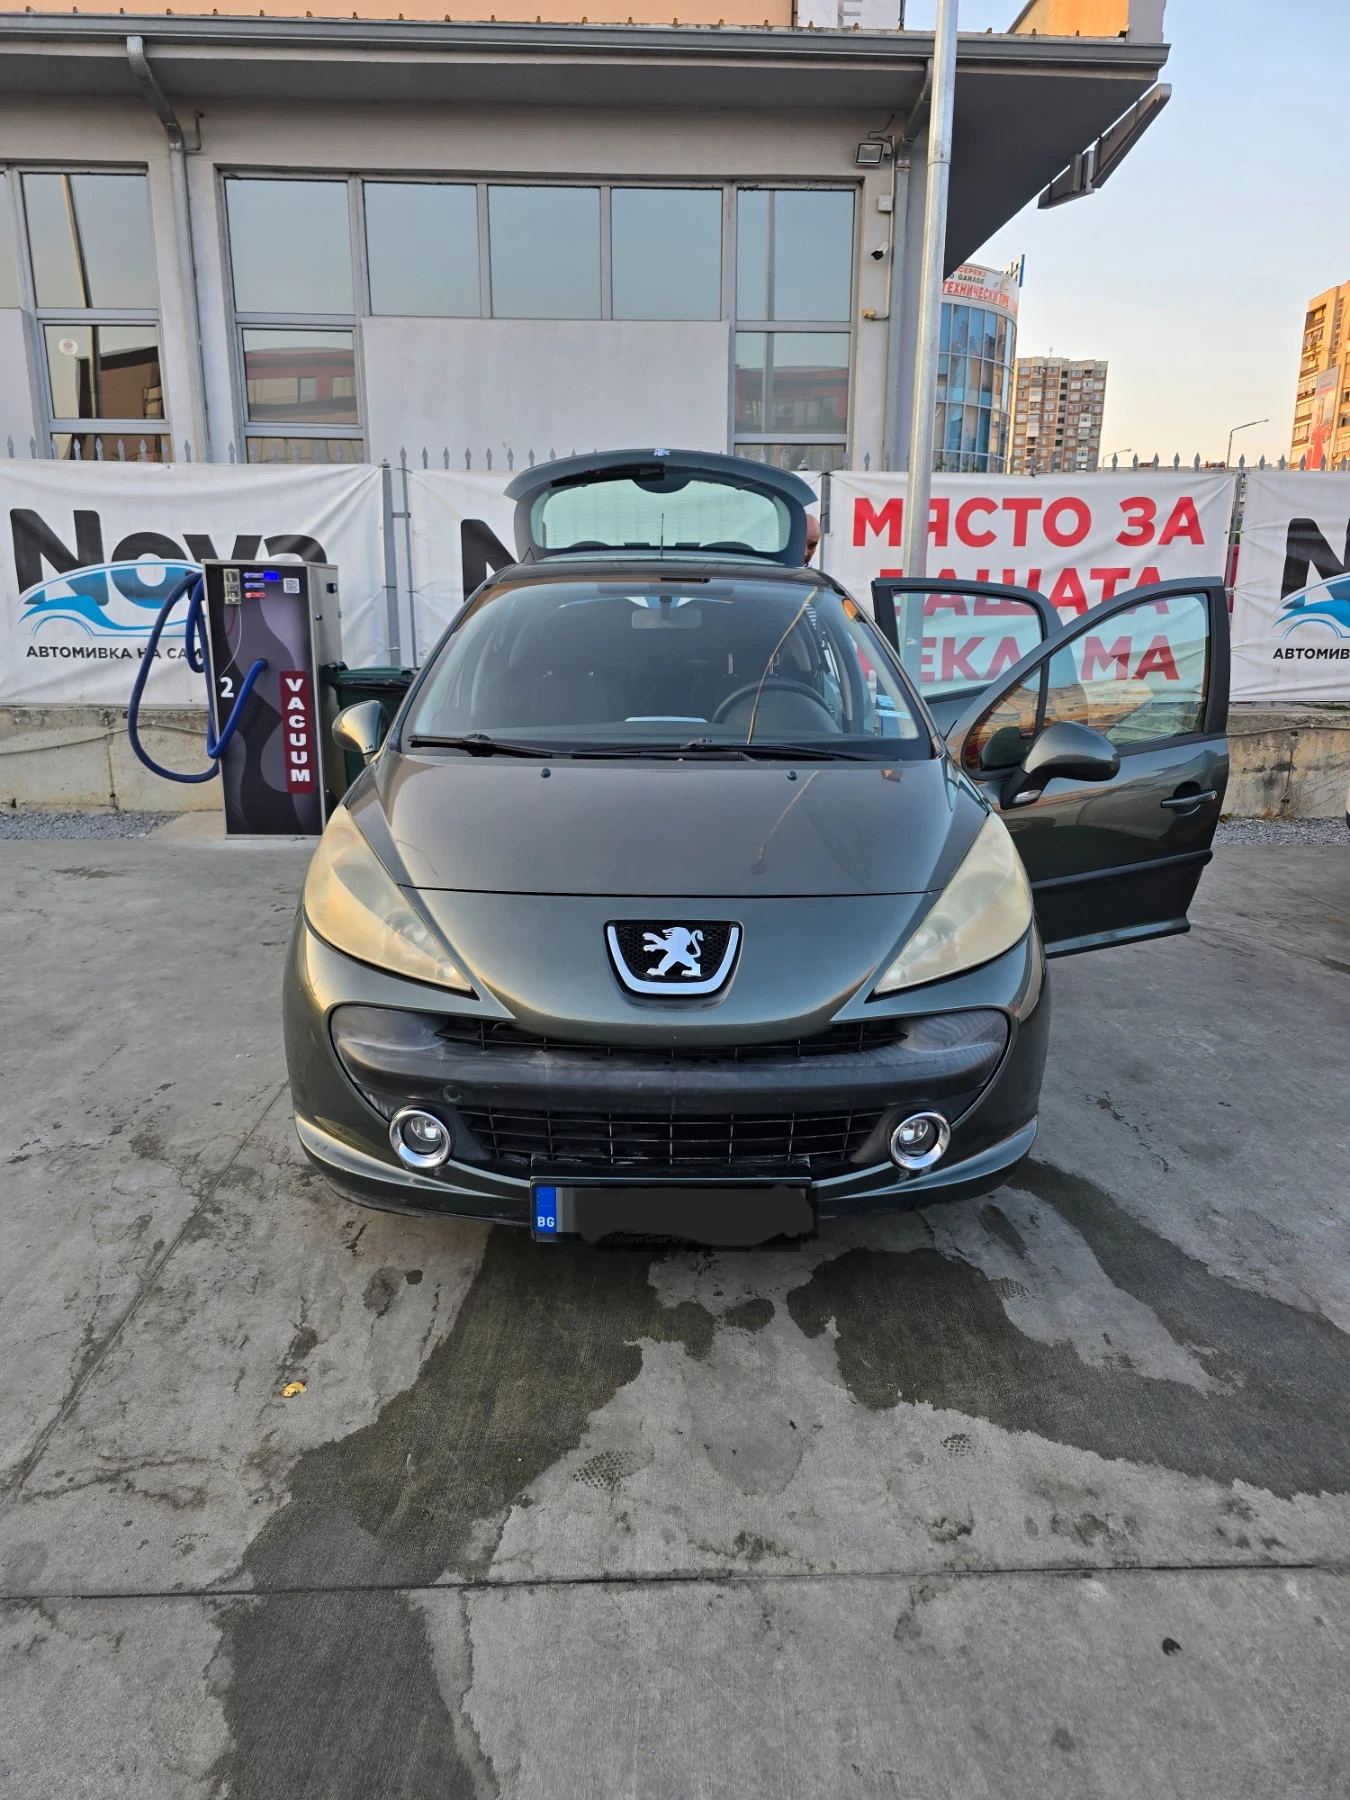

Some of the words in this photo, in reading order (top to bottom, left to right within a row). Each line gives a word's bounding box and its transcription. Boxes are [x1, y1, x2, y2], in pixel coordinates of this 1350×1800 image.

[957, 266, 987, 278] СЕРВИЗ
[957, 273, 985, 285] GARAGE
[1115, 496, 1206, 547] ЗА
[26, 645, 133, 659] АВТОМИВКА
[219, 676, 235, 698] 2
[285, 678, 311, 782] VACUUM
[537, 1216, 555, 1228] BG
